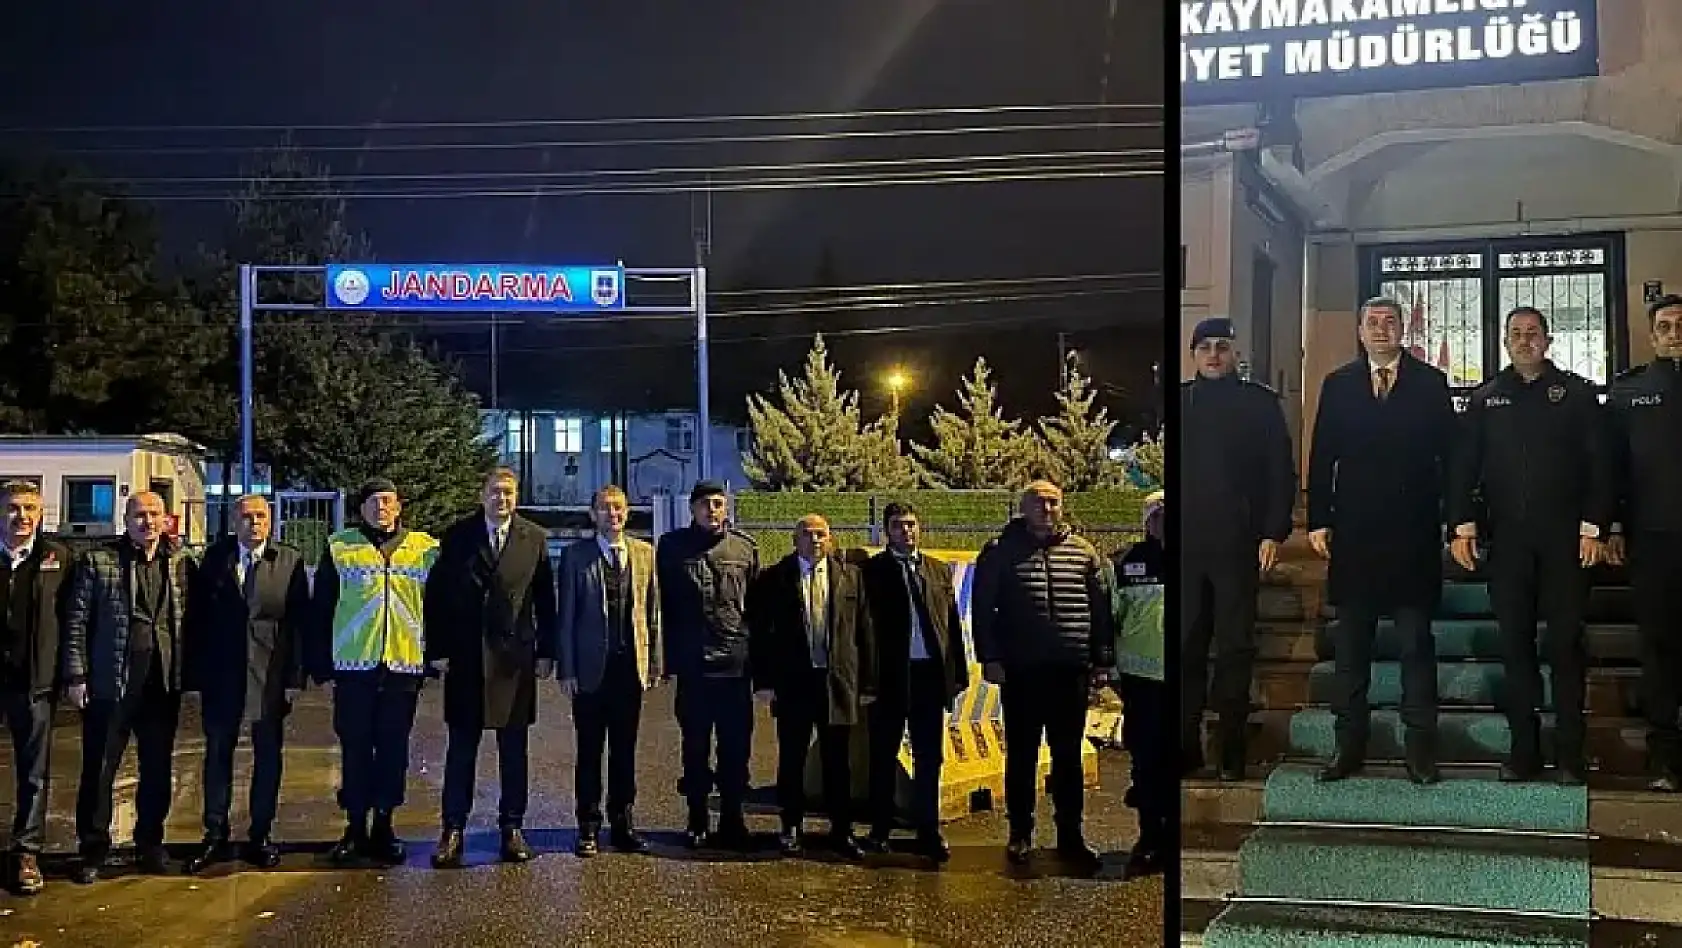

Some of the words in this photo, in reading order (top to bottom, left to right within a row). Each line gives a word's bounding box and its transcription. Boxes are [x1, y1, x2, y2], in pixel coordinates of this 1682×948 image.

[1181, 0, 1527, 34] KAYMAKAM
[1284, 11, 1581, 75] MÜDÜRLÜĞÜ
[382, 270, 572, 301] JANDARMA
